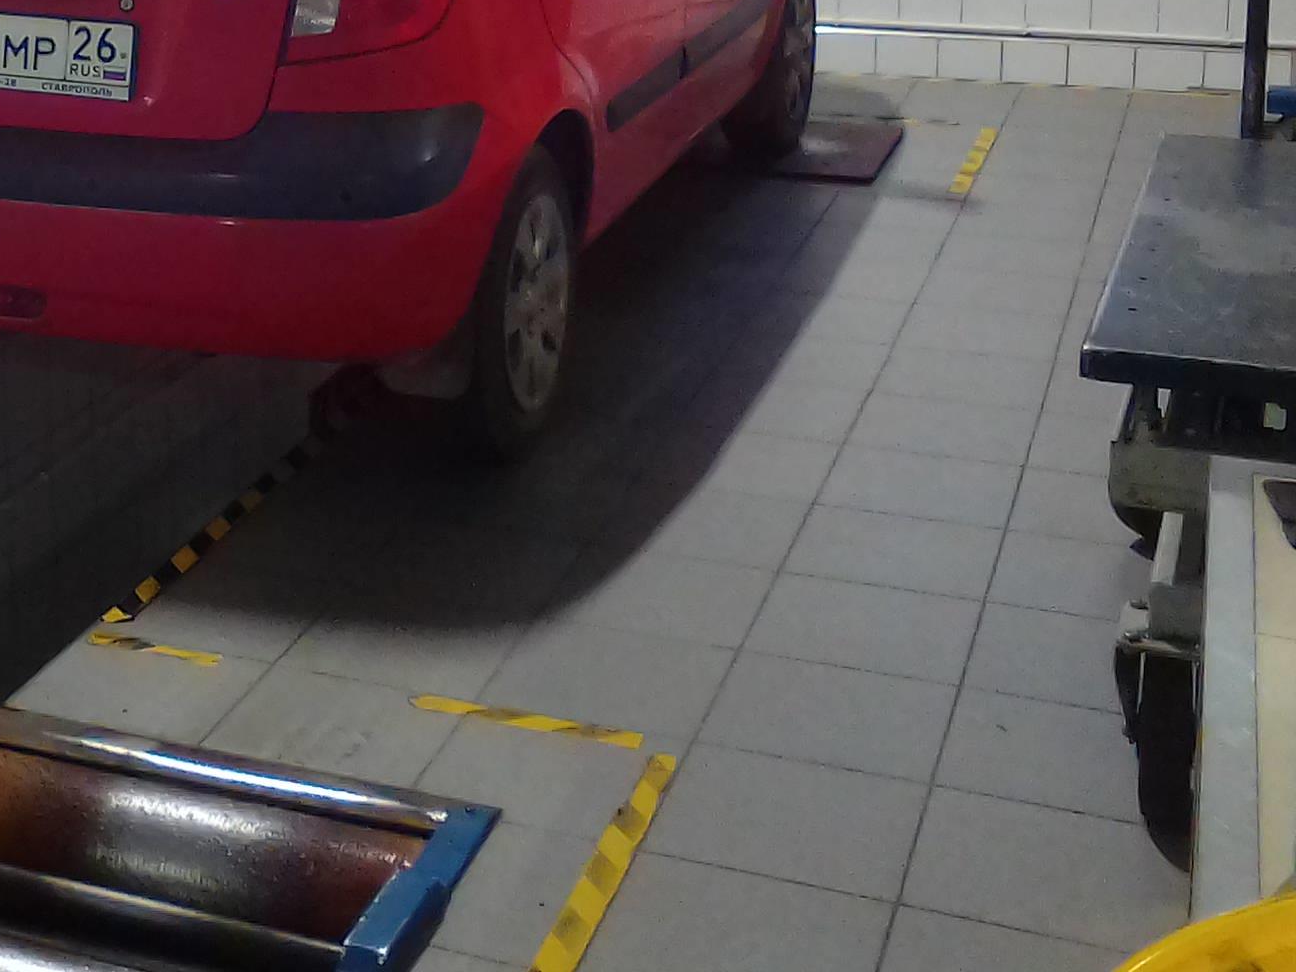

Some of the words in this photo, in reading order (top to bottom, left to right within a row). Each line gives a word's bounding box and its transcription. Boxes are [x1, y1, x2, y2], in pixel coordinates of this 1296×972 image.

[72, 26, 116, 64] 26
[69, 62, 102, 78] RUS
[41, 81, 113, 98] СТАВРОПОЛЬ
